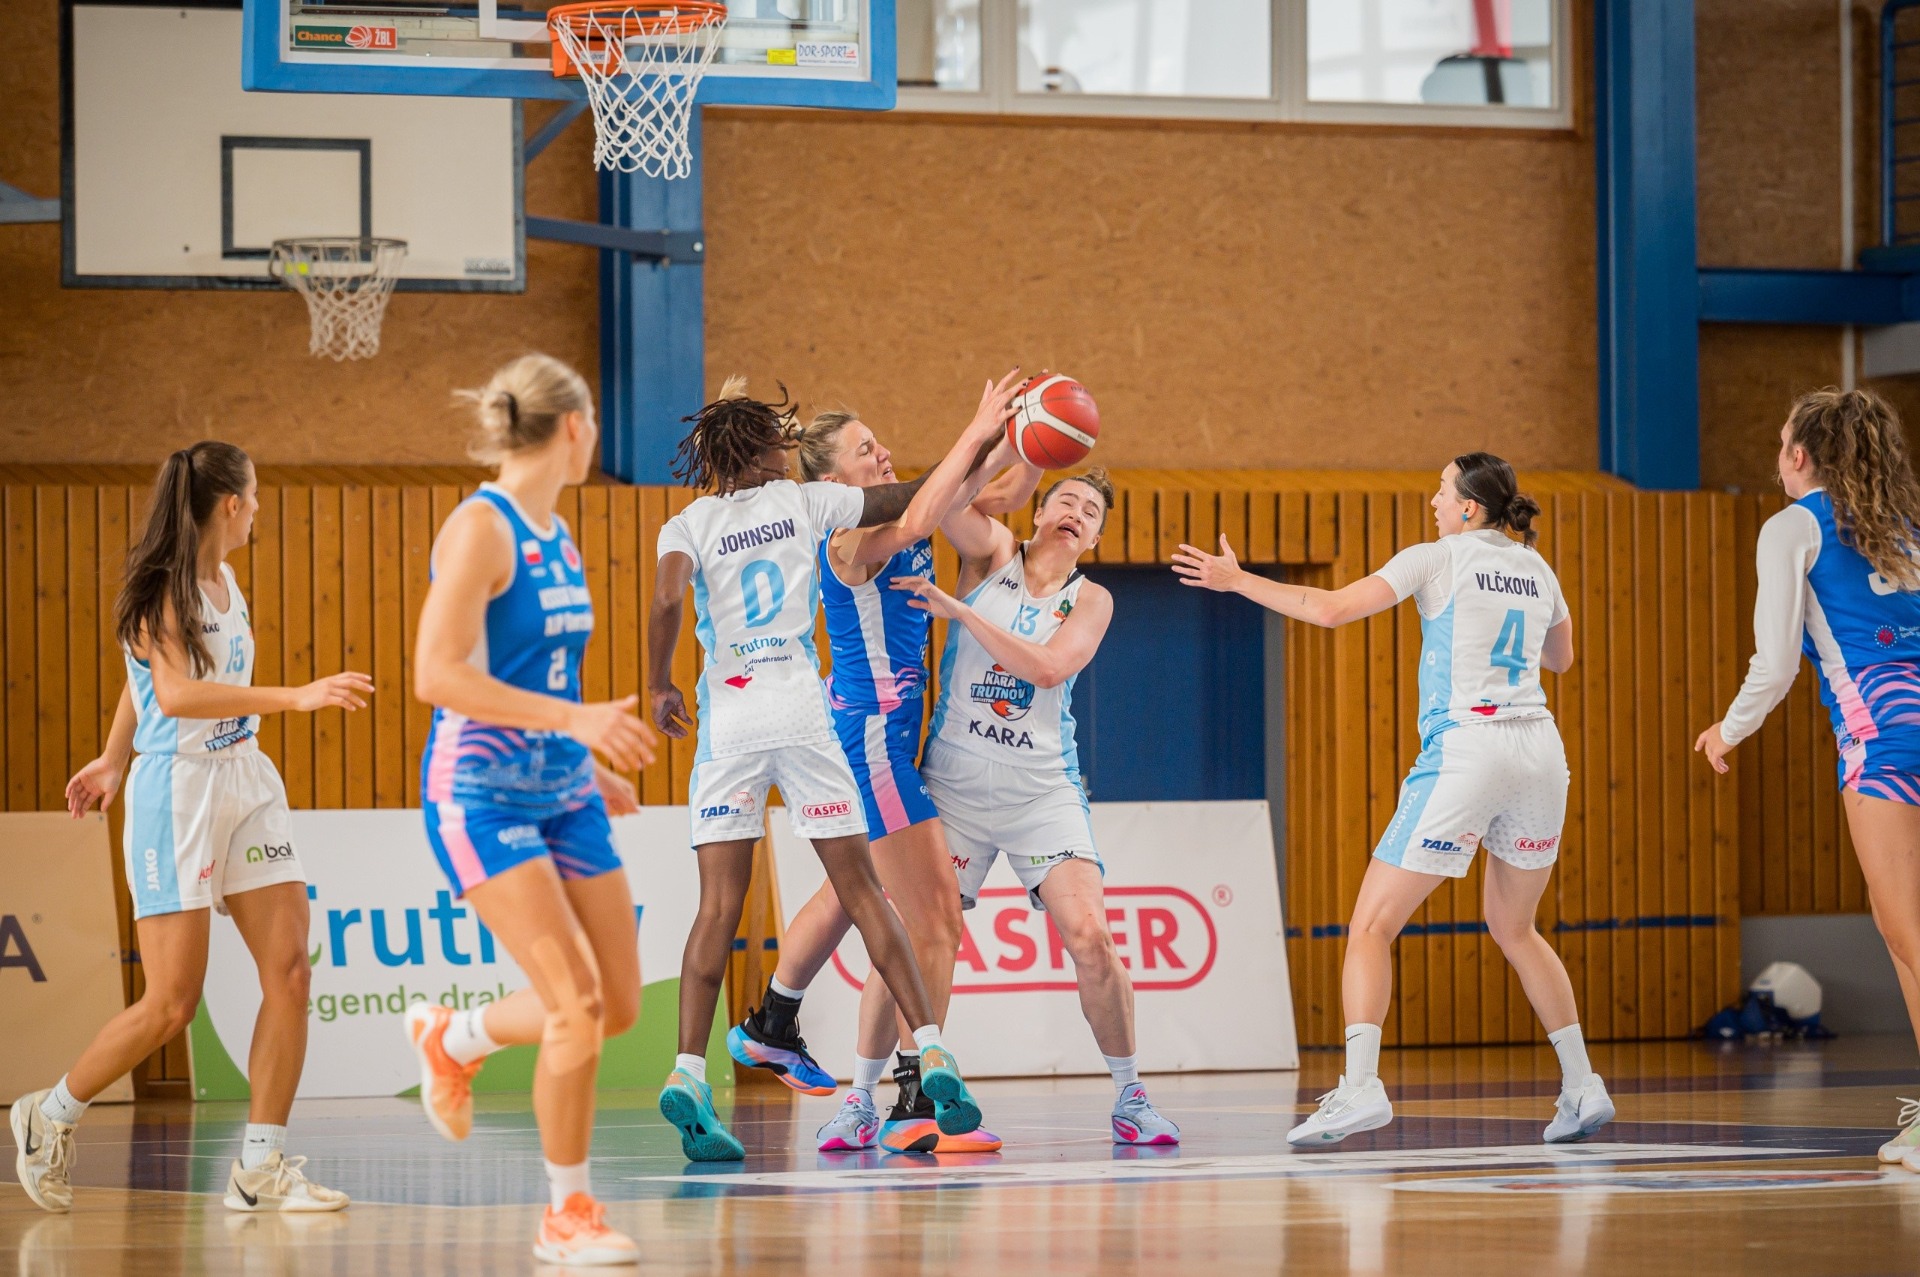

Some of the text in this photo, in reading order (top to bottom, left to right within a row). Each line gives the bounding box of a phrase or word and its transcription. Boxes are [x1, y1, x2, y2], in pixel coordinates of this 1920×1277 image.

[297, 28, 392, 46] Chance ŽBL
[798, 45, 847, 58] DOR-SPORT
[718, 519, 795, 556] JOHNSON
[741, 559, 785, 628] 0
[1475, 571, 1539, 598] VLČKOVÁ
[202, 623, 220, 634] AKO
[1010, 604, 1040, 636] 13
[225, 635, 245, 674] 15
[730, 637, 787, 657] Trutnov
[1490, 608, 1528, 686] 4
[547, 647, 567, 690] 2
[985, 671, 1016, 688] KARA
[971, 684, 1026, 700] TRUTNOV
[214, 720, 240, 738] KARA
[969, 719, 1033, 749] KARA
[701, 805, 740, 818] TAD.cz
[807, 803, 849, 816] KASPER
[1387, 790, 1420, 847] Trutnov
[1421, 838, 1461, 852] TAD.cz
[144, 849, 160, 891] JAKO
